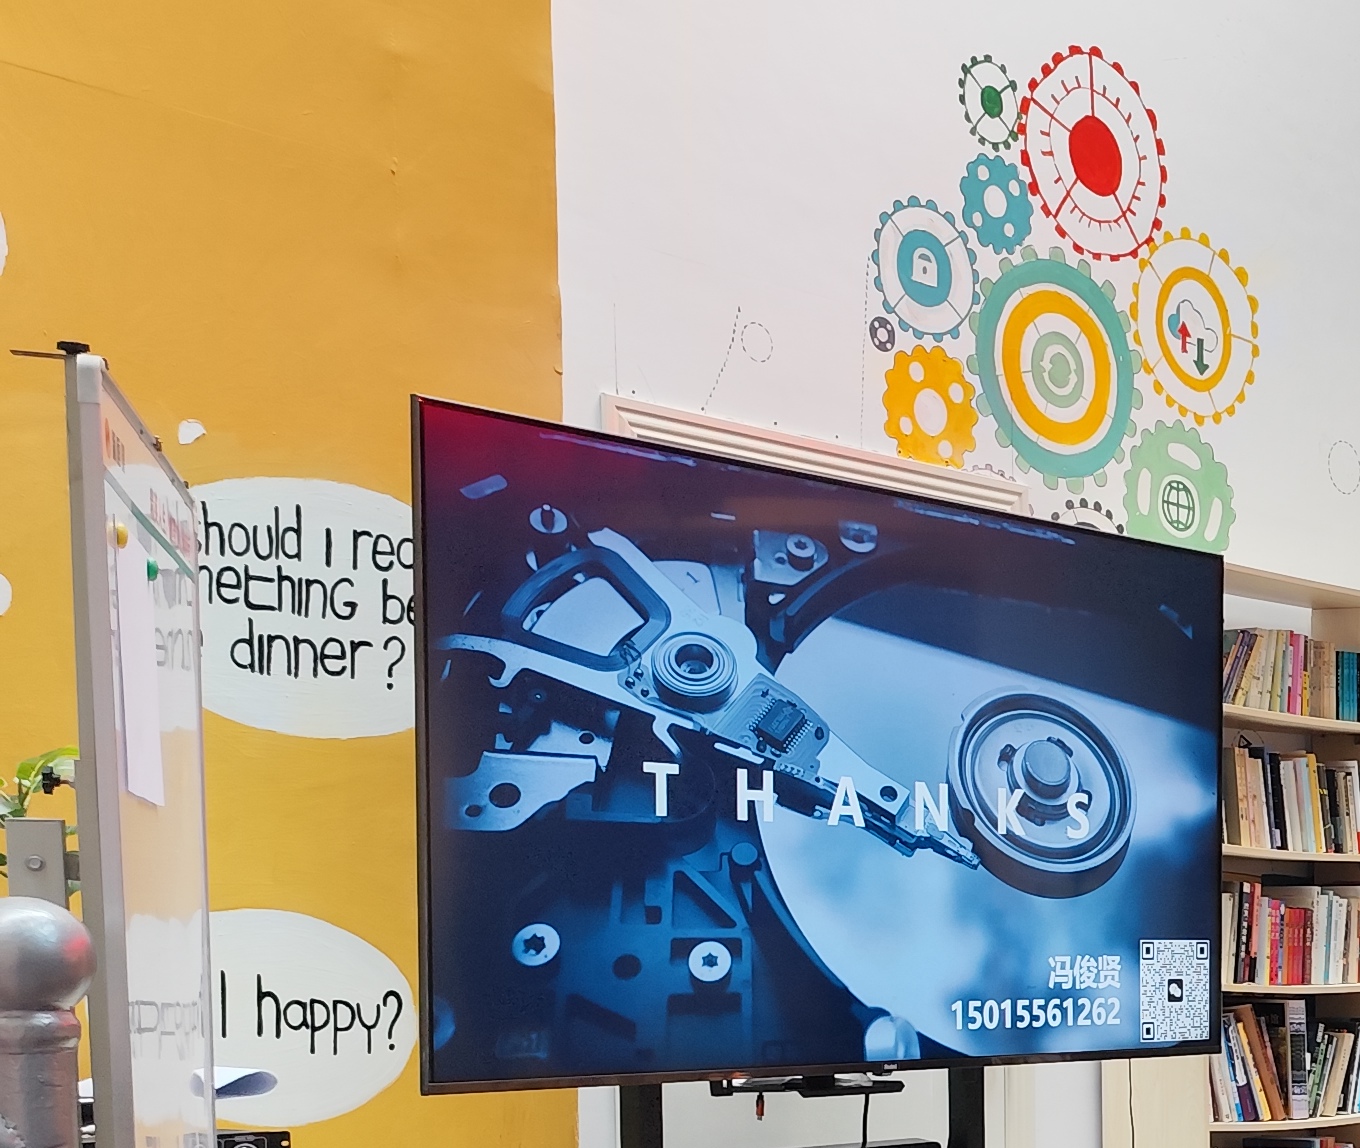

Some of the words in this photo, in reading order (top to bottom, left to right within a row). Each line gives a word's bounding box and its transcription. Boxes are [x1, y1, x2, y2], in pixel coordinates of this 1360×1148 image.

[642, 761, 1092, 840] THANKS
[1048, 955, 1122, 990] 冯俊贤
[950, 998, 1122, 1031] 15015561262
